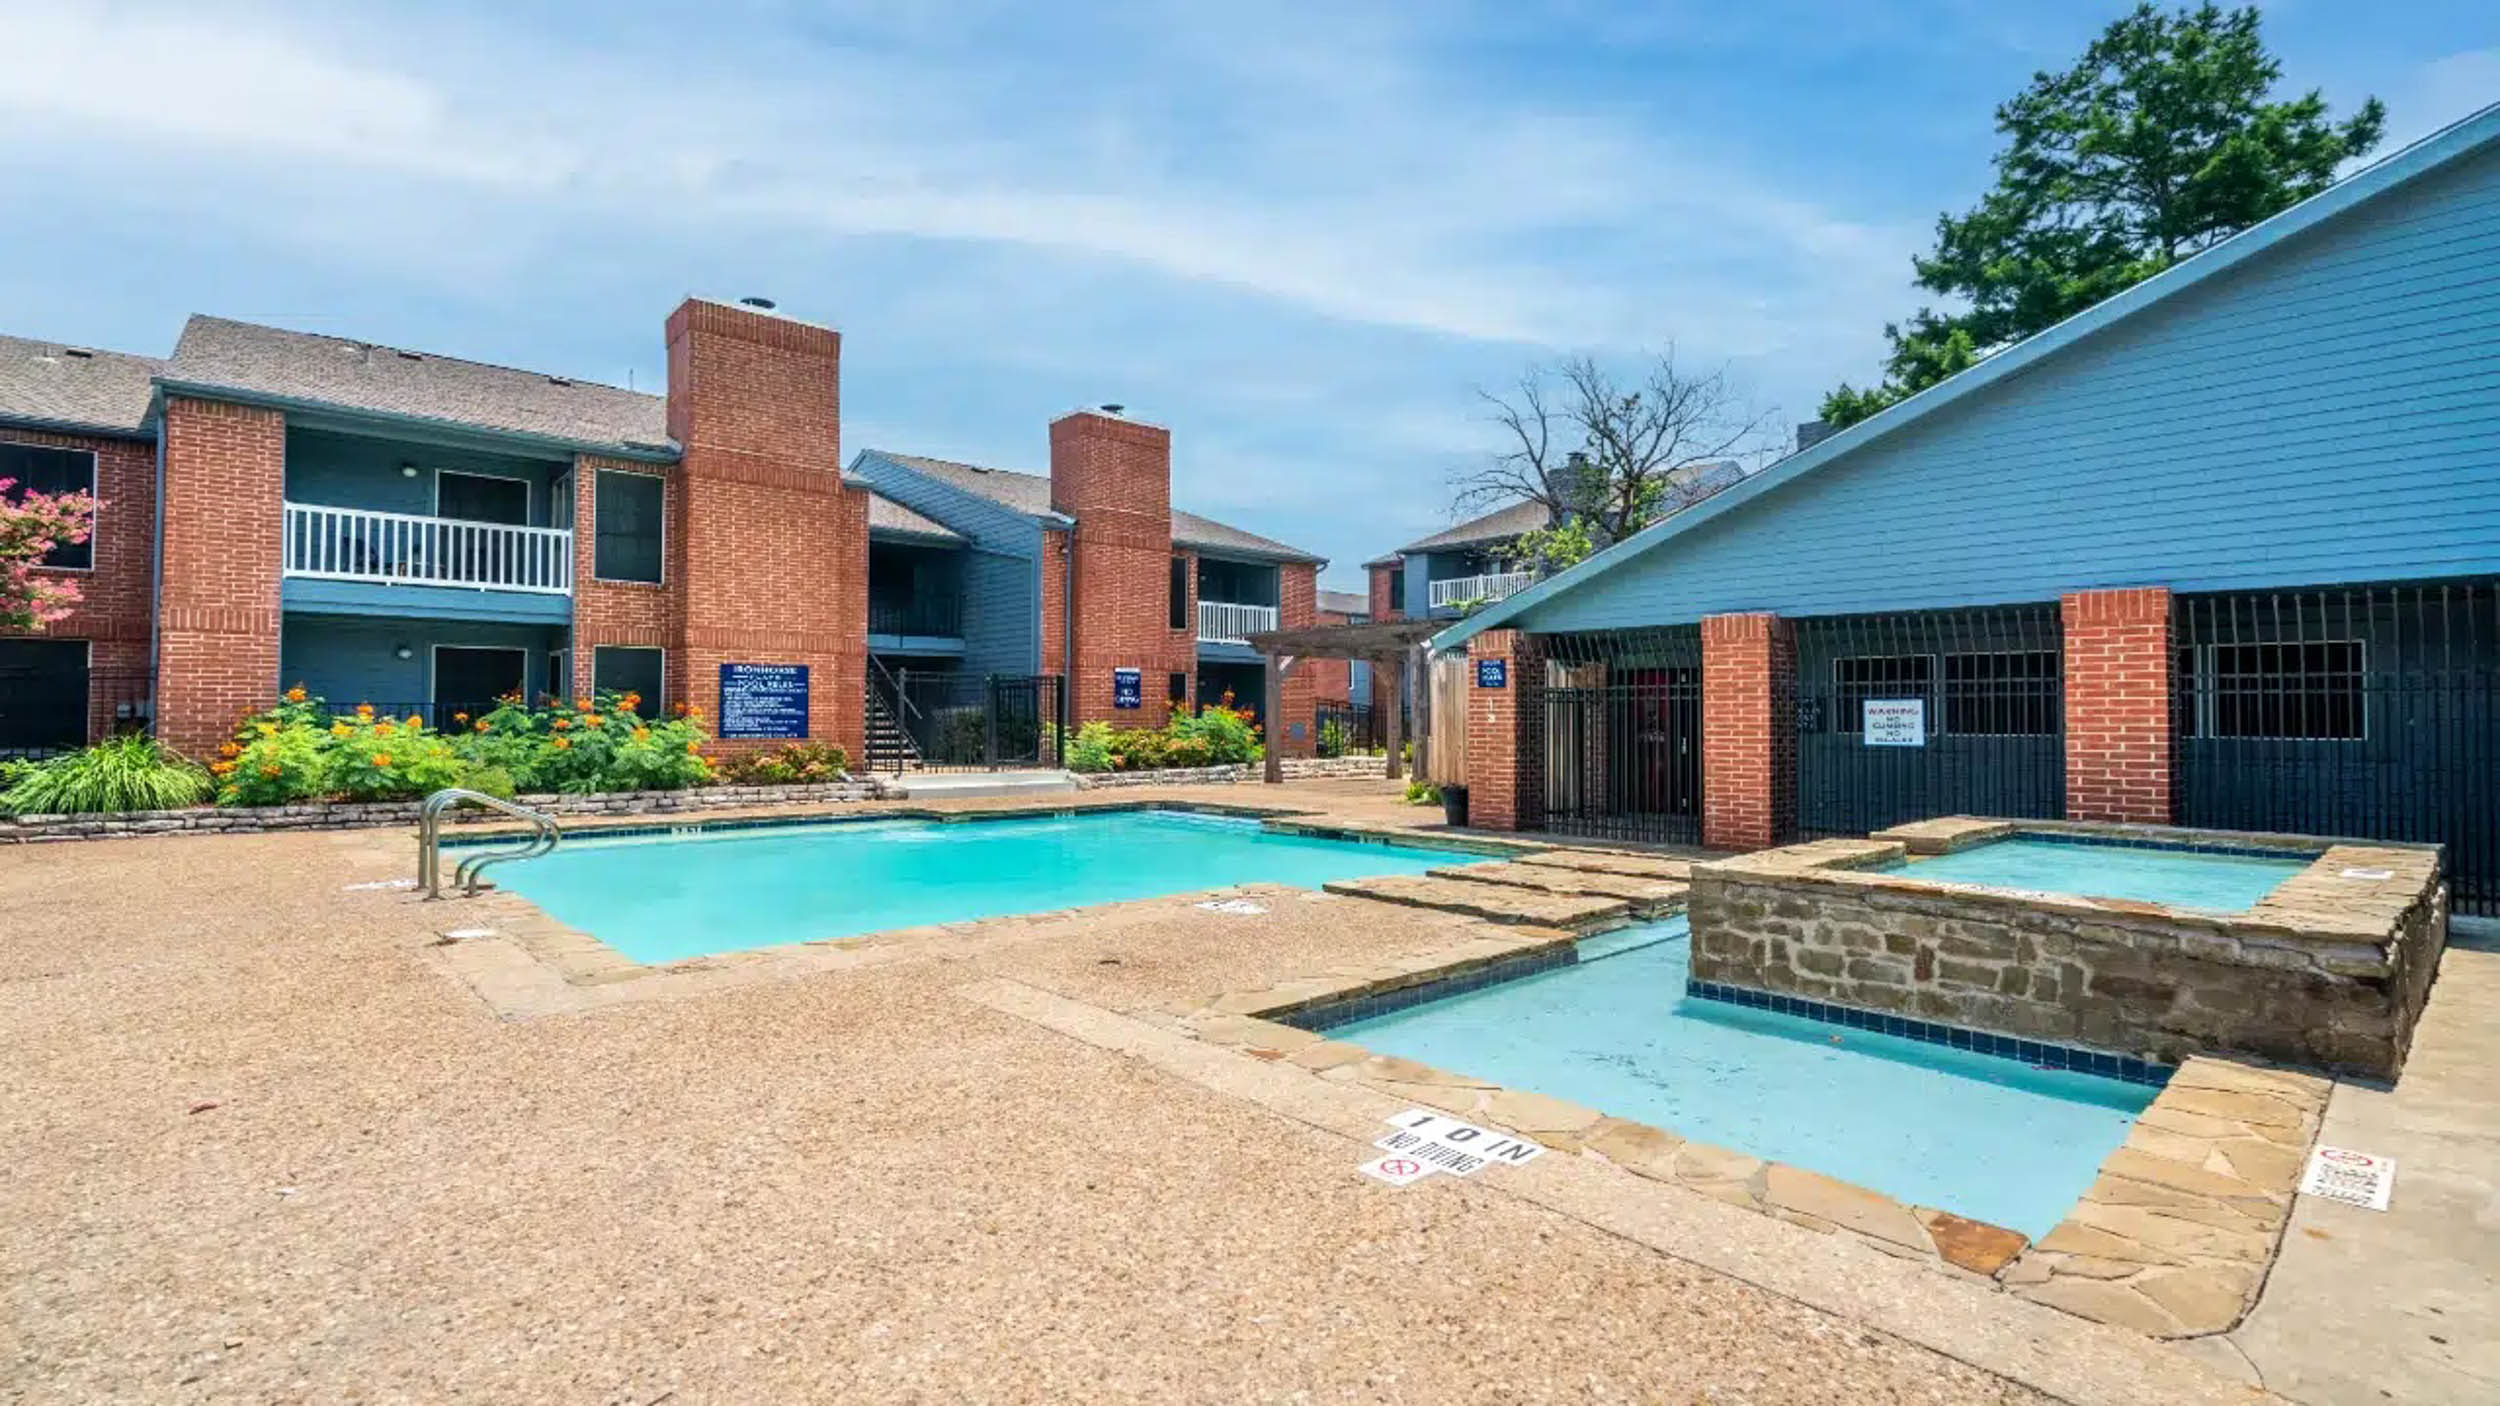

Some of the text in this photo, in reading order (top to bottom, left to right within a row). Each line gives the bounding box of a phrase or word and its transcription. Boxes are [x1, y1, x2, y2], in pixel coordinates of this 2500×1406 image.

[737, 680, 764, 688] POOL
[1867, 708, 1919, 716] WARNING
[1381, 1131, 1485, 1173] NO DIVING
[1484, 1139, 1537, 1161] IN
